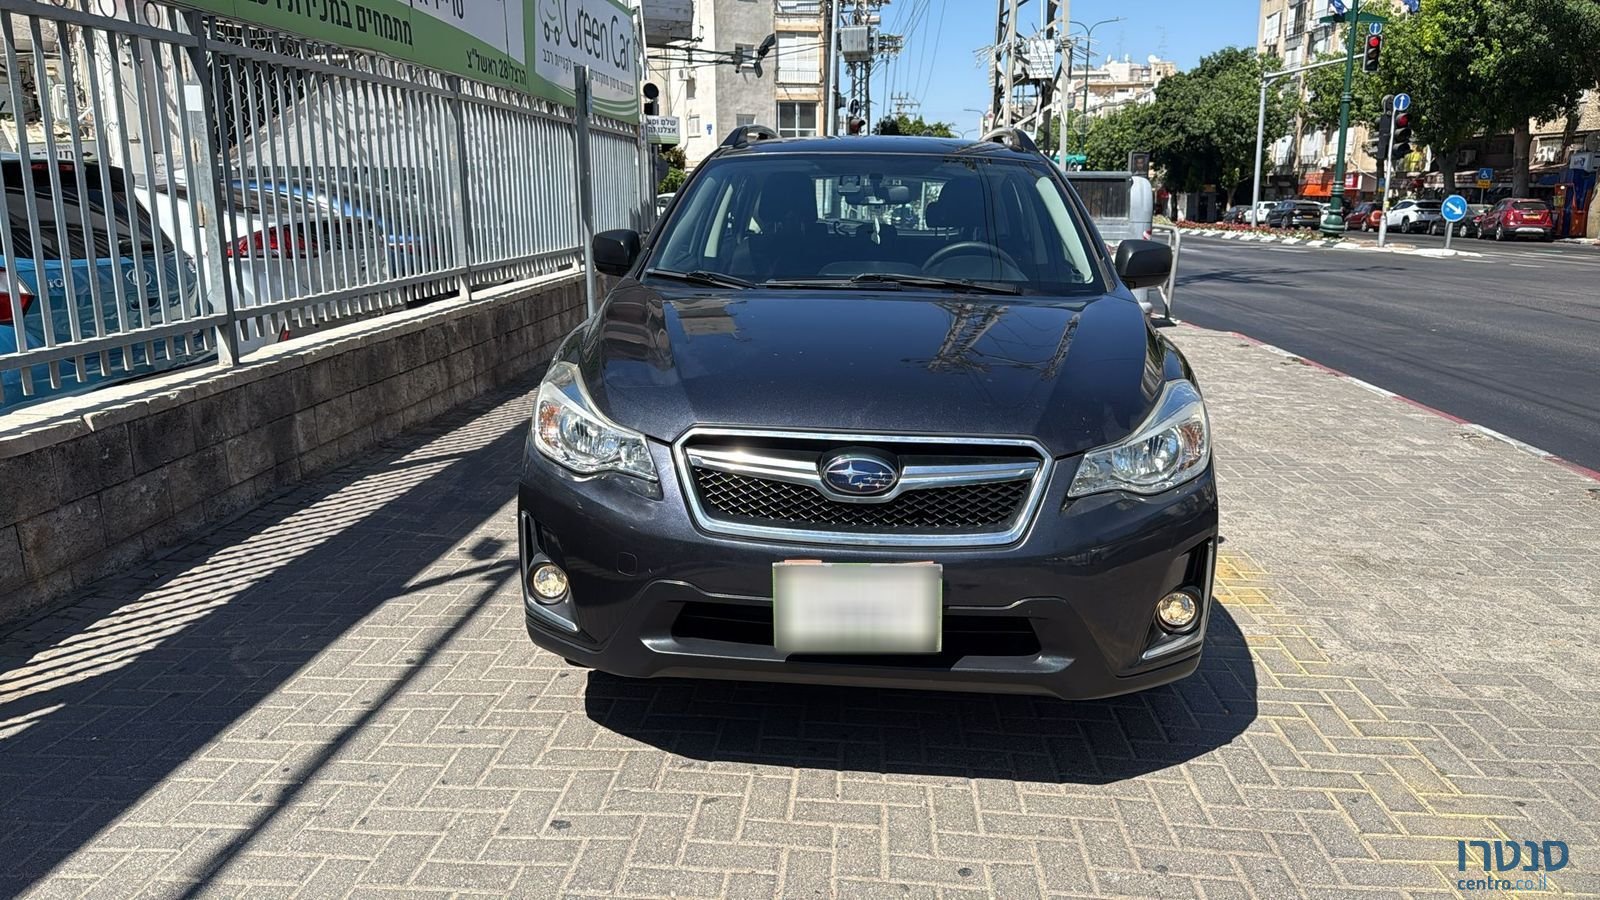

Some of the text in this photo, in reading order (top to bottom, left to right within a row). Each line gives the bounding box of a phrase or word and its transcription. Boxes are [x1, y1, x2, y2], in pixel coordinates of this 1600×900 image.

[355, 4, 414, 46] מתמחים
[564, 0, 630, 72] Green Car
[497, 58, 508, 80] 28
[542, 48, 554, 65] רכב
[508, 60, 527, 86] הרצל
